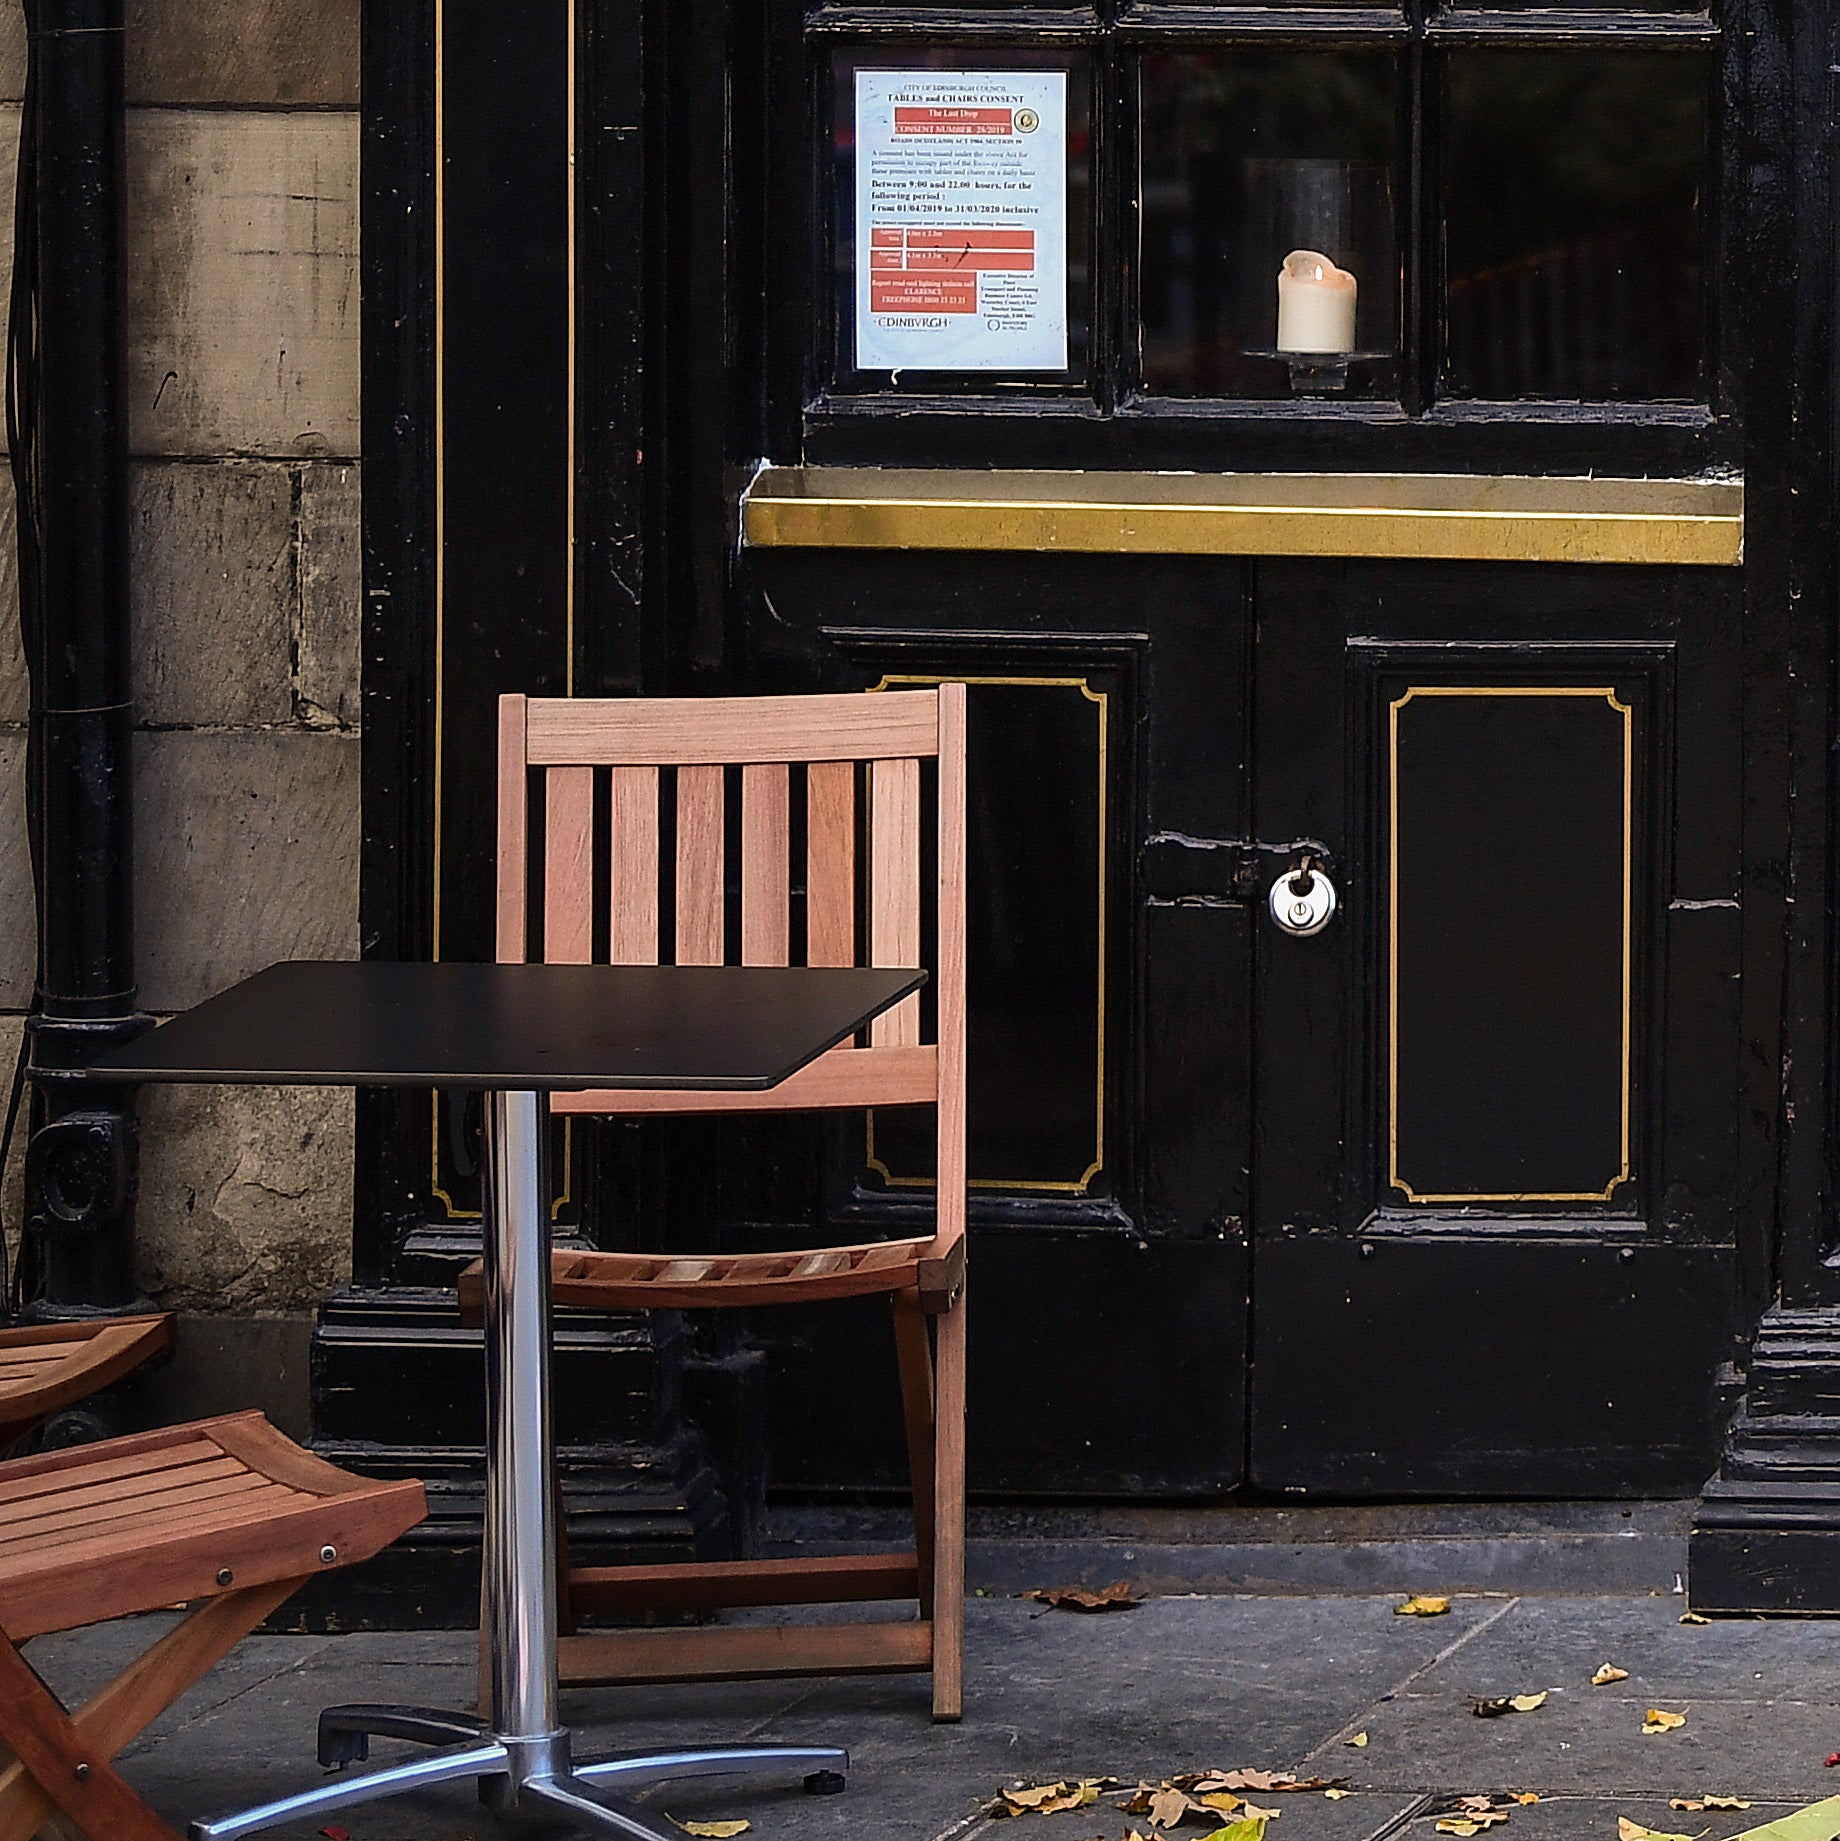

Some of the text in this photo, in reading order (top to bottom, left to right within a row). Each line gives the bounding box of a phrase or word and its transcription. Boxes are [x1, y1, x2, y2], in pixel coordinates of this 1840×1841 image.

[887, 94, 923, 103] TABLES
[941, 94, 978, 103] CHAIRS
[980, 95, 1024, 103] CONSENT
